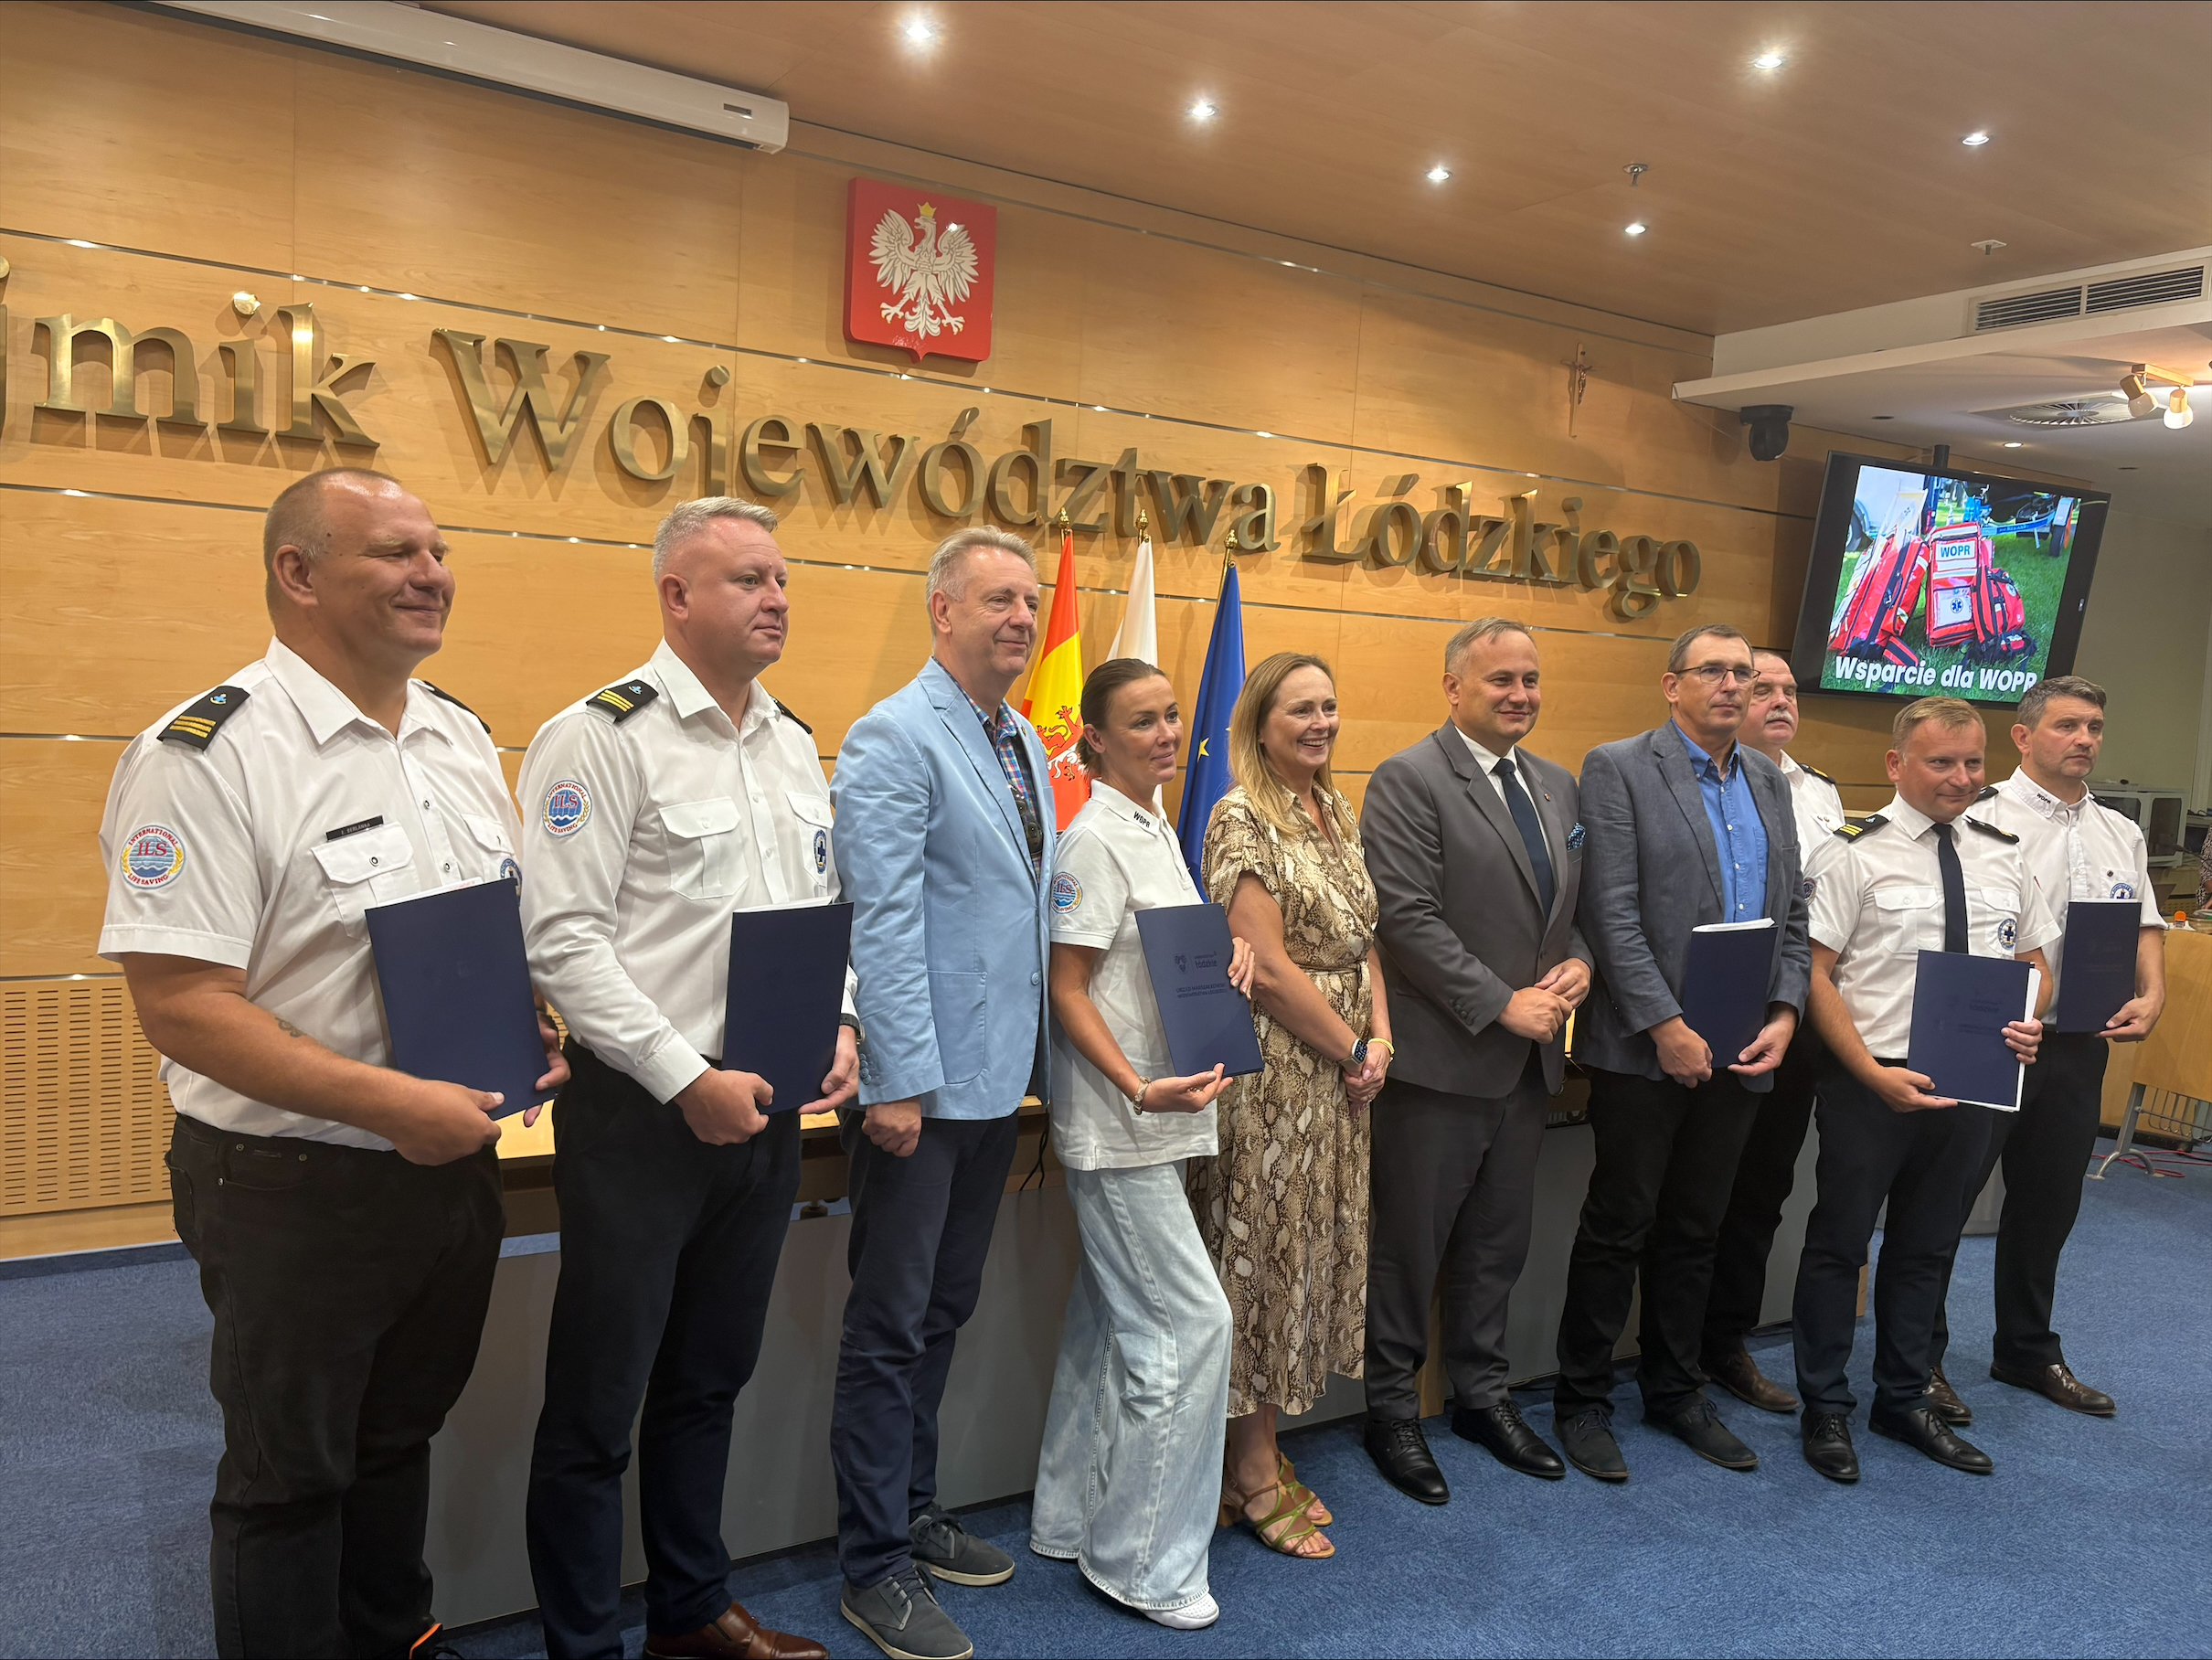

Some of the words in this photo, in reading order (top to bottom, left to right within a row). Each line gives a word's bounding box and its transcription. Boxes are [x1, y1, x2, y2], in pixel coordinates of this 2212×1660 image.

[430, 328, 1281, 552] Województwa
[1301, 462, 1701, 618] Łódzkiego
[1940, 545, 1971, 558] WOPR
[1835, 656, 1937, 688] Wsparcie
[1941, 665, 1975, 688] dla
[554, 794, 578, 808] ILS
[1133, 810, 1151, 828] WOPR
[128, 827, 178, 847] INTERNATIONAL
[137, 841, 167, 857] ILS
